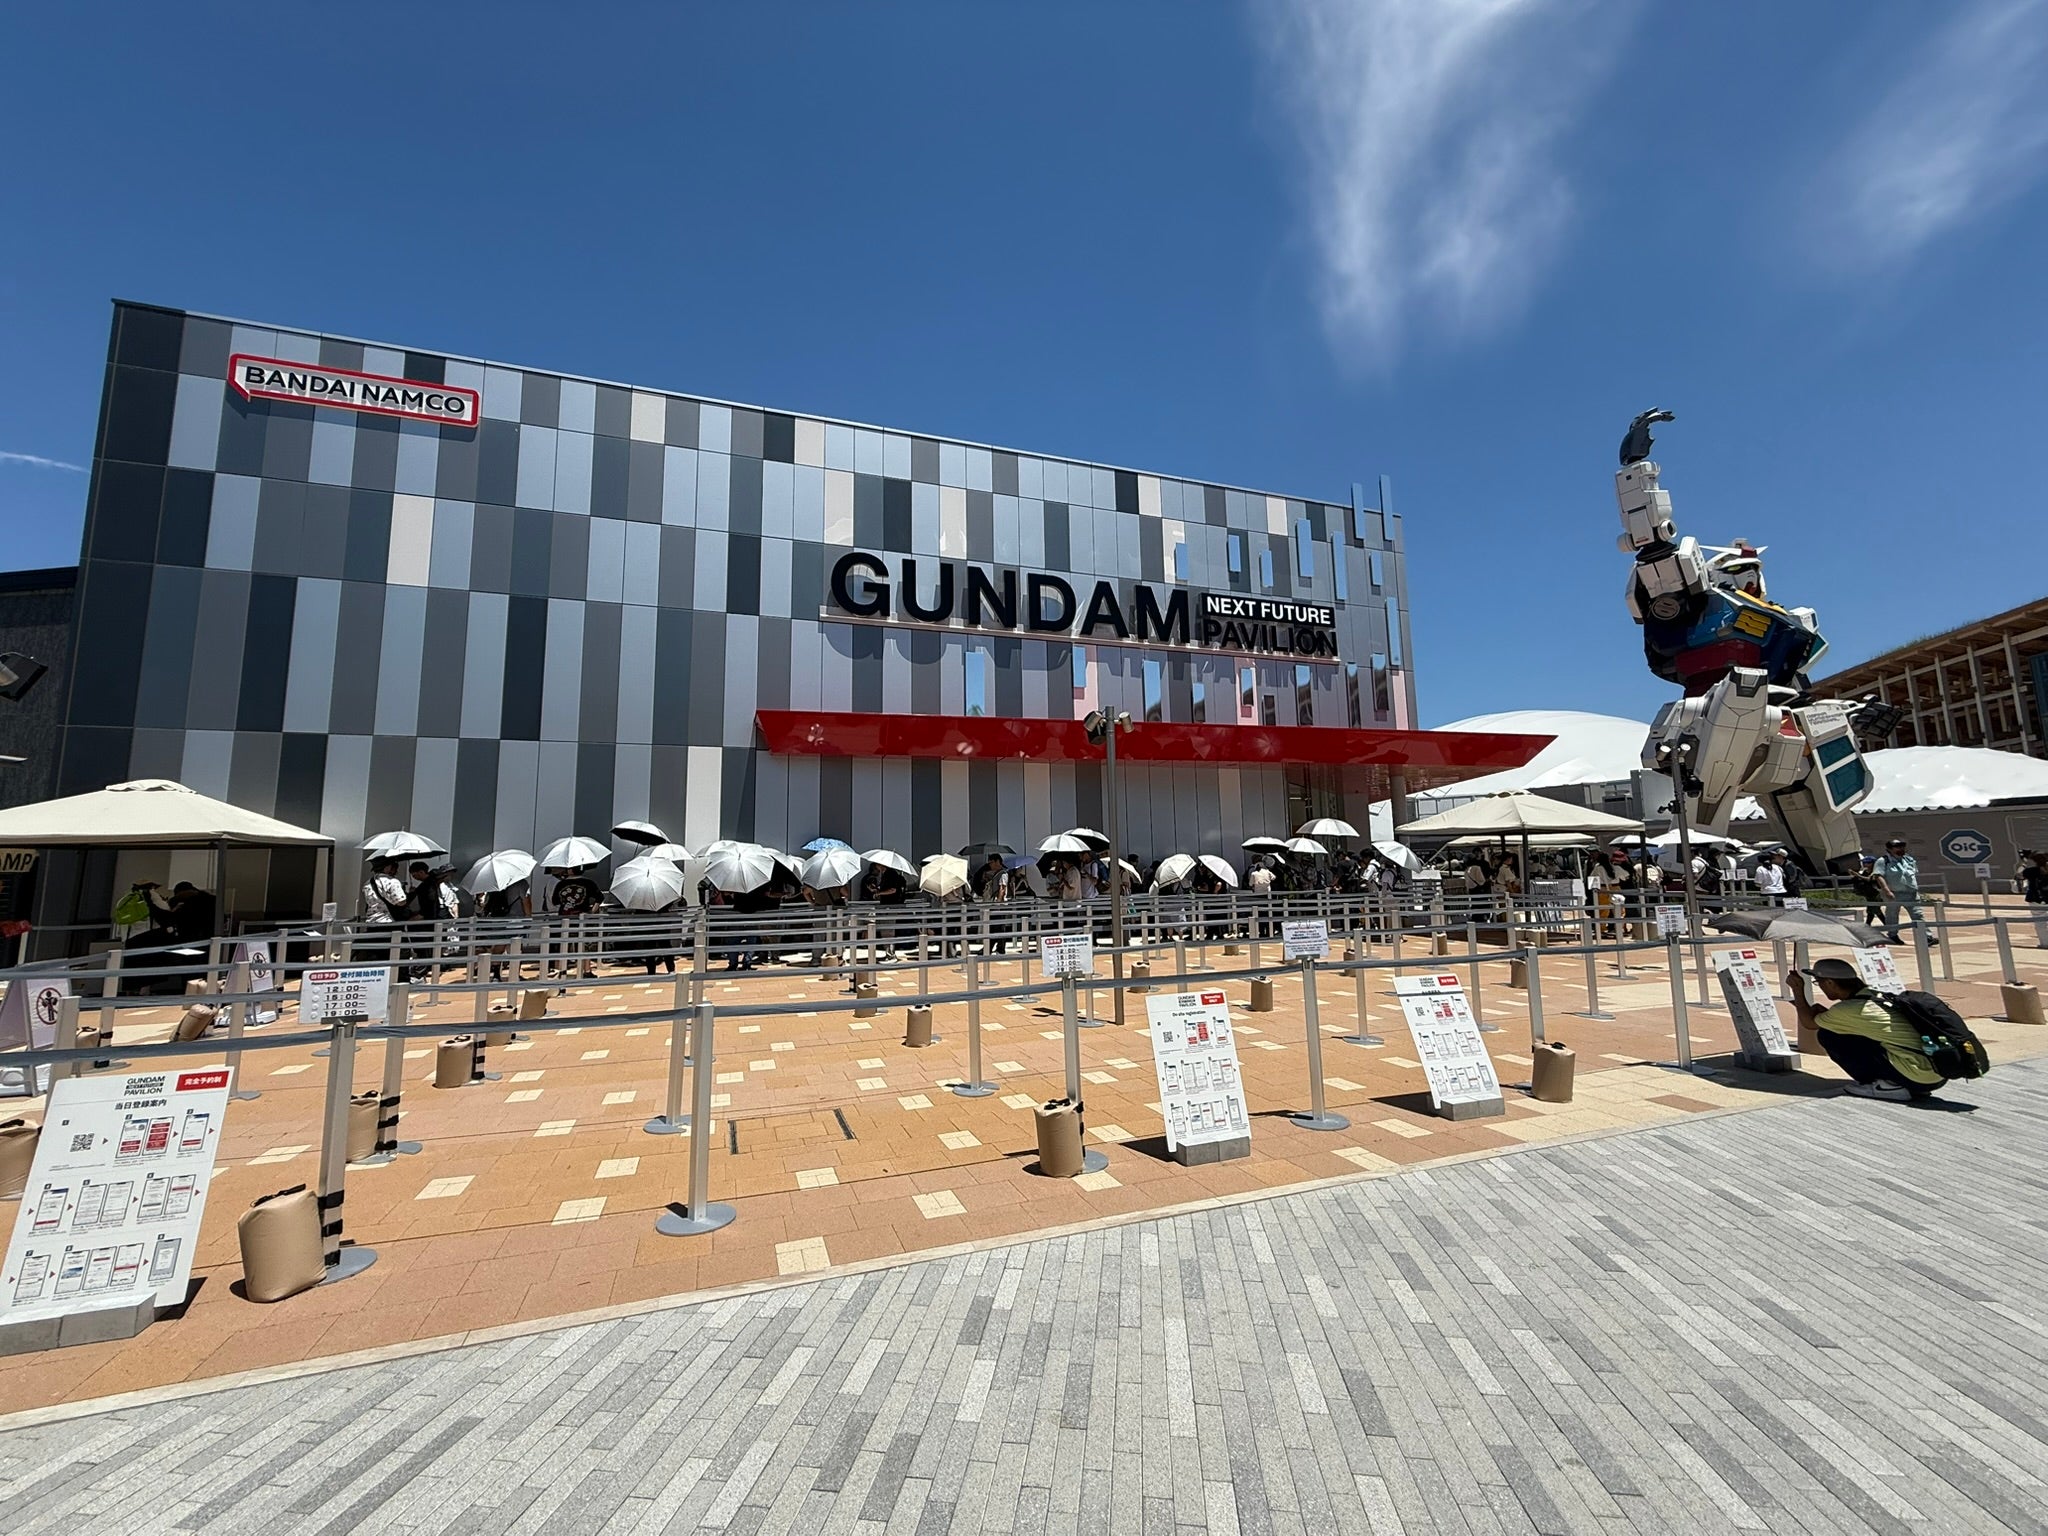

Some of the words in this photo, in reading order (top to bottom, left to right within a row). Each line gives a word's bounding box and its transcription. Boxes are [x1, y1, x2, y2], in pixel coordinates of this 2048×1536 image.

[245, 366, 355, 398] BANDAI
[361, 382, 465, 413] NAMCO
[830, 552, 1190, 644] GUNDAM
[1207, 596, 1256, 617] NEXT
[1261, 602, 1331, 624] FUTURE
[1202, 619, 1338, 657] PAVILION
[0, 853, 32, 871] MP
[124, 1087, 162, 1096] PAVILION
[127, 1076, 165, 1085] GUNDAM
[115, 1099, 167, 1110] 当日登録案内
